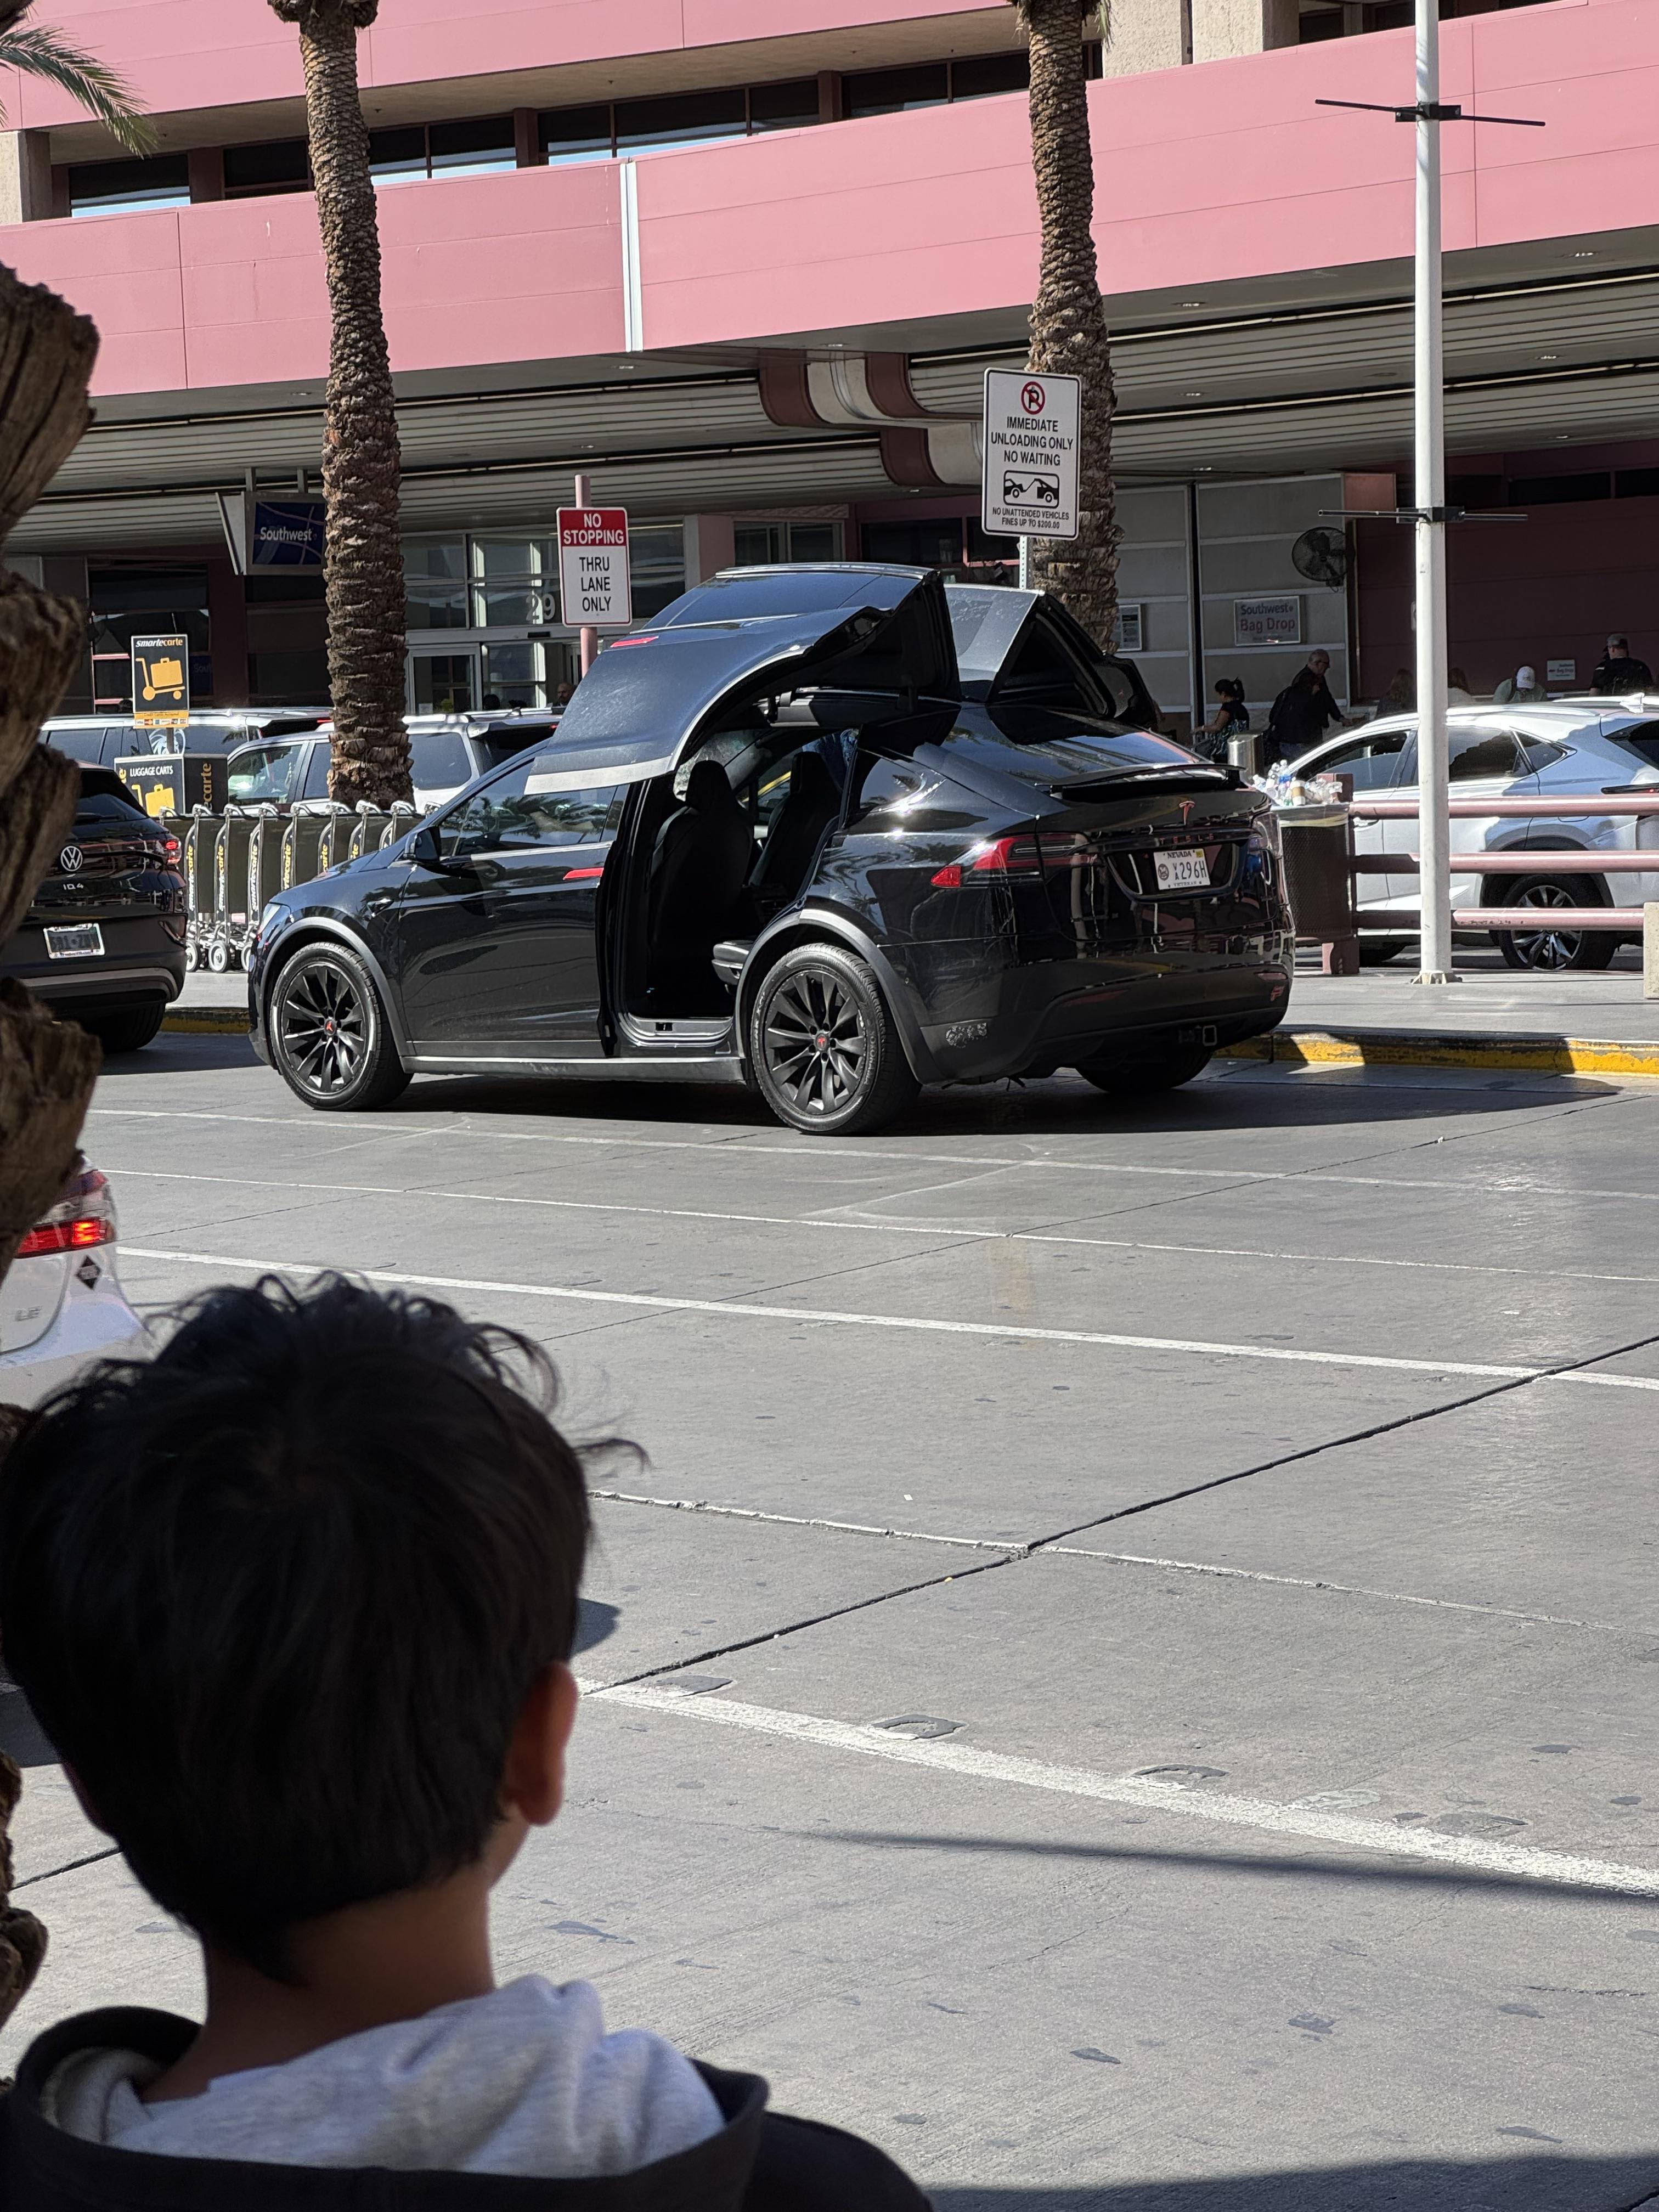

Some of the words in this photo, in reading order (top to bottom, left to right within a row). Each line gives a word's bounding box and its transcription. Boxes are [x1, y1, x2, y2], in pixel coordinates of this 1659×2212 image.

[1007, 416, 1058, 432] IMMEDIATE
[991, 432, 1046, 448] UNLOADING
[1049, 437, 1073, 450] ONLY
[1004, 450, 1018, 462] NO
[1020, 452, 1060, 466] WAITING
[584, 513, 601, 528] NO
[992, 507, 1001, 515] NO
[1002, 507, 1040, 518] UNATTENDED
[1042, 511, 1069, 520] VEHICLES
[1002, 517, 1018, 526] FINES
[1019, 518, 1027, 527] UP
[1029, 518, 1036, 527] TO
[1037, 520, 1060, 529] $200.00
[260, 526, 312, 541] Southwest
[563, 529, 624, 544] STOPPING
[579, 557, 610, 572] THRU
[581, 577, 611, 591] LANE
[526, 594, 555, 621] 29
[582, 596, 611, 612] ONLY
[1241, 603, 1288, 615] Southwest
[1240, 618, 1262, 633] Bag
[1266, 617, 1295, 632] Drop
[136, 638, 183, 647] smartecarte
[130, 767, 155, 777] LUGGAGE
[156, 766, 173, 775] CARTS
[1167, 850, 1192, 859] NEVADA
